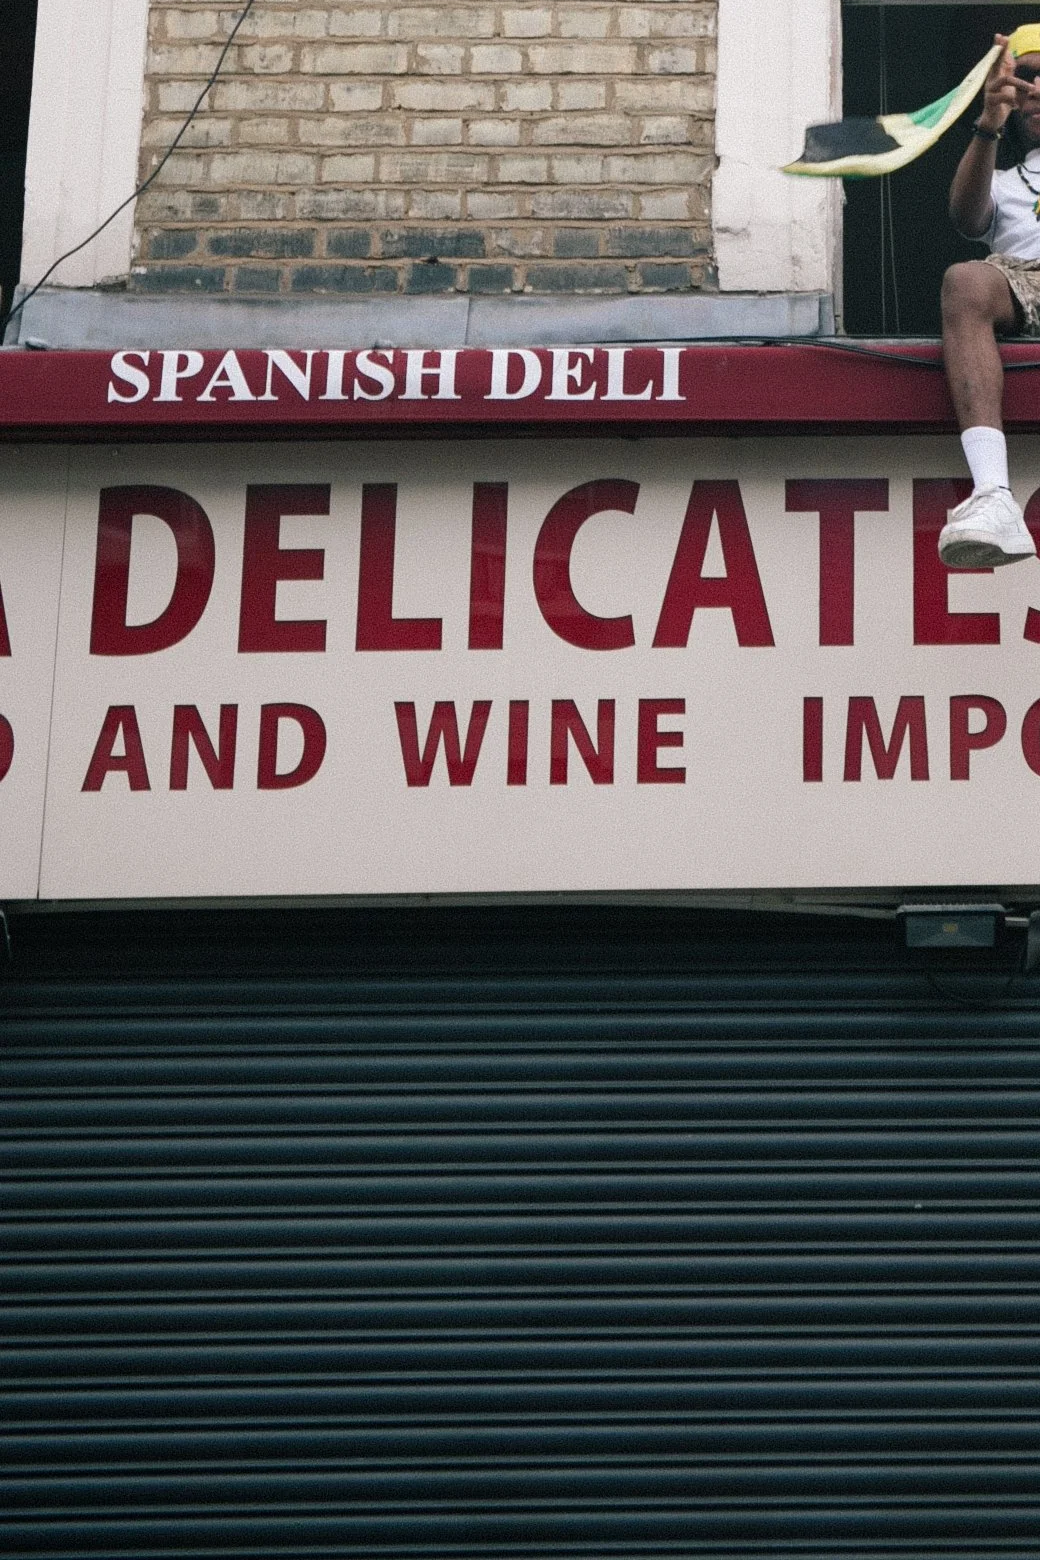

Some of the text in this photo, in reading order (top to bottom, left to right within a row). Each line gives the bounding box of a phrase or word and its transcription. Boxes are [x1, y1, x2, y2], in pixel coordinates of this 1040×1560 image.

[107, 347, 688, 403] SPANISH DELI
[81, 702, 328, 792] AND
[394, 698, 687, 788] WINE
